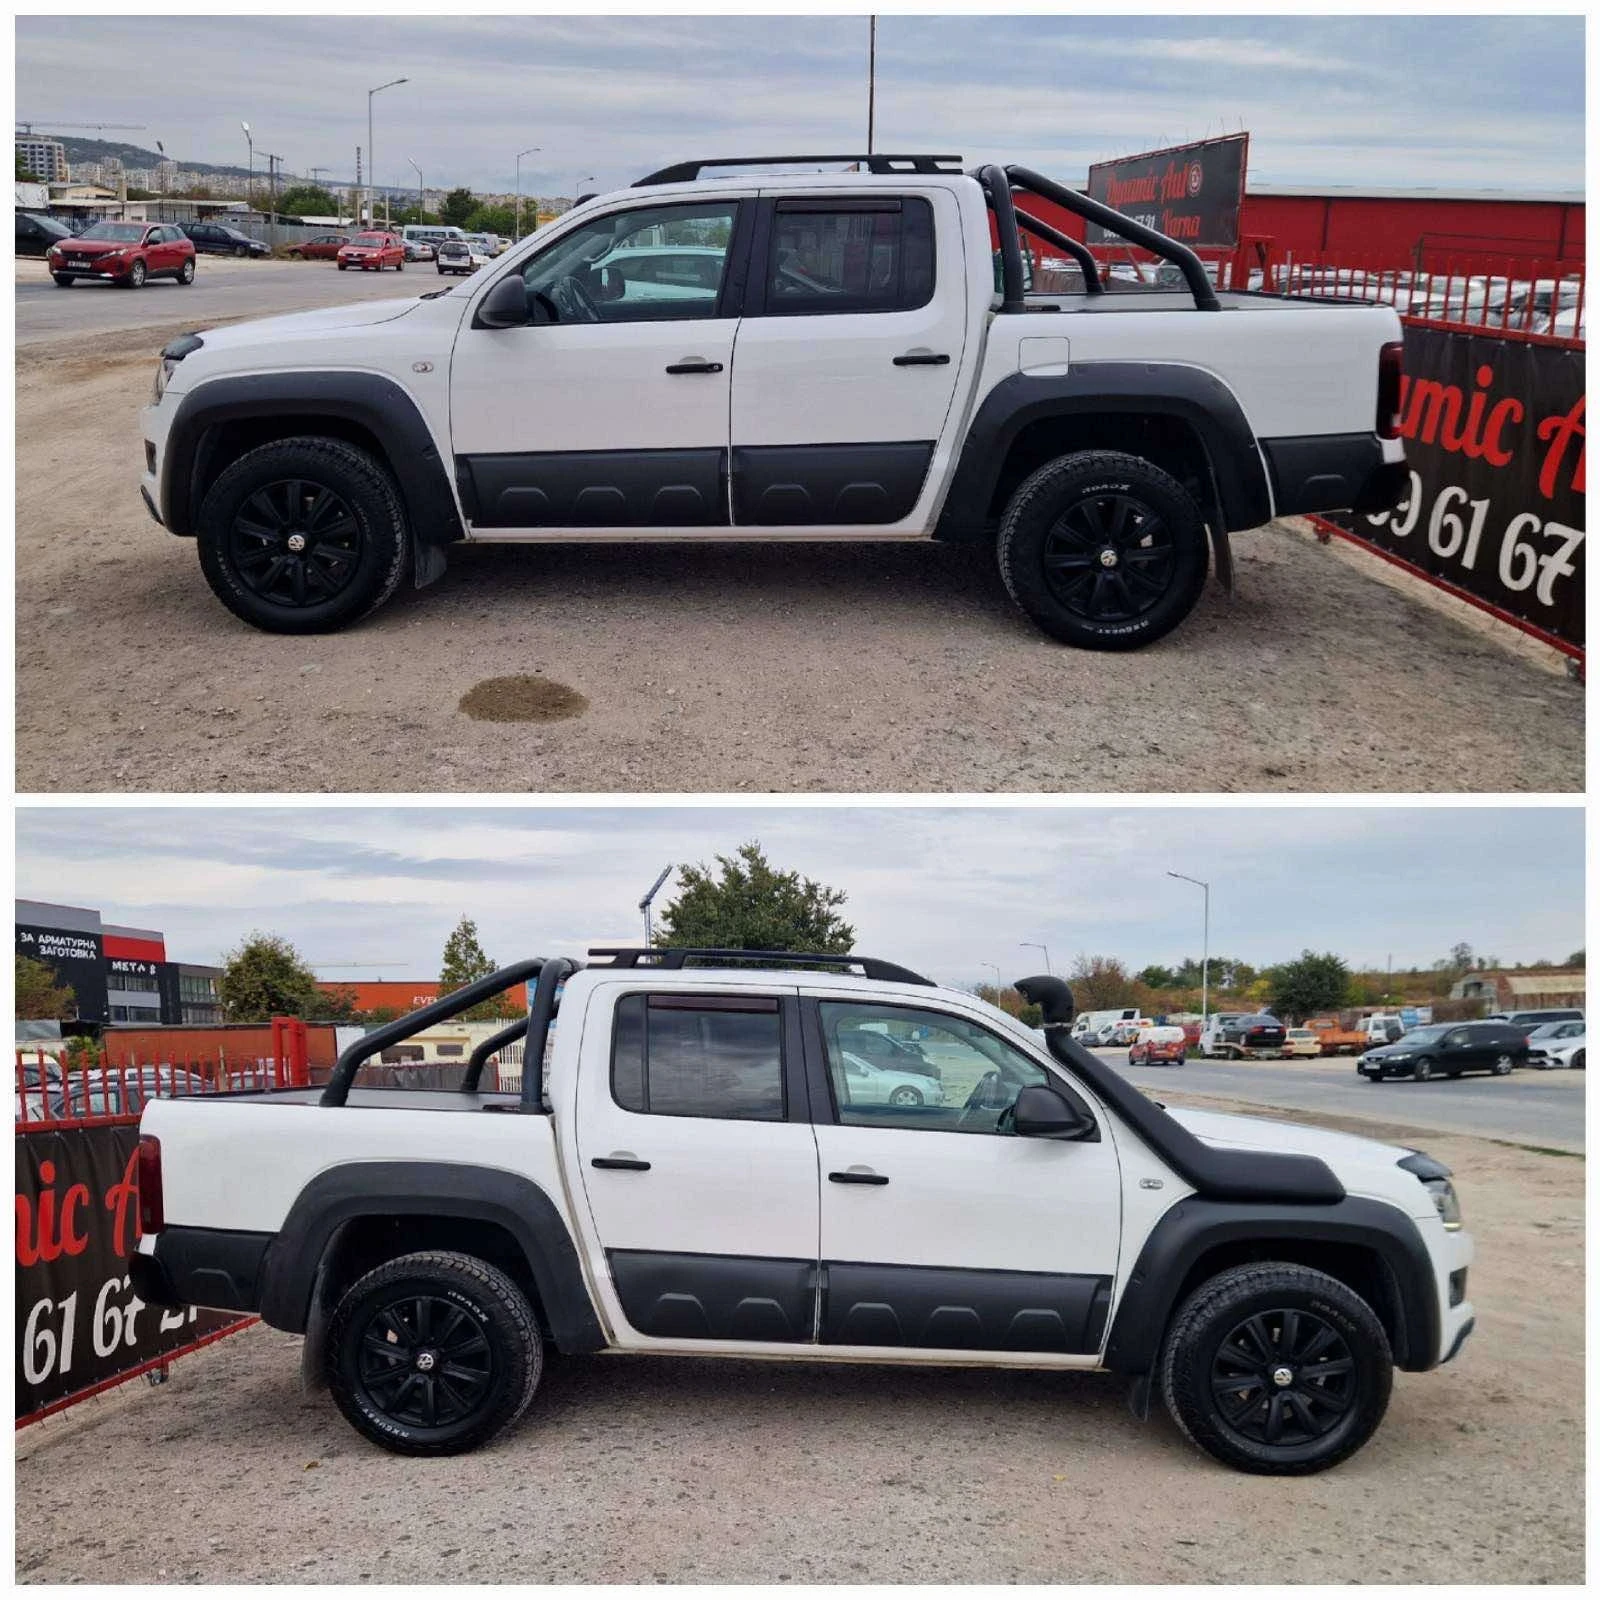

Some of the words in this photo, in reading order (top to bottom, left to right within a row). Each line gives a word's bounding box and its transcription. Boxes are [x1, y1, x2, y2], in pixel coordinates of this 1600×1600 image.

[1161, 208, 1200, 238] Varna
[1428, 486, 1490, 570] 61
[1499, 512, 1585, 606] 67
[20, 932, 34, 943] ЗА
[38, 934, 97, 949] АРМАТУРНА
[40, 945, 97, 960] ЗАГОТОВКА
[23, 1291, 77, 1385] 61
